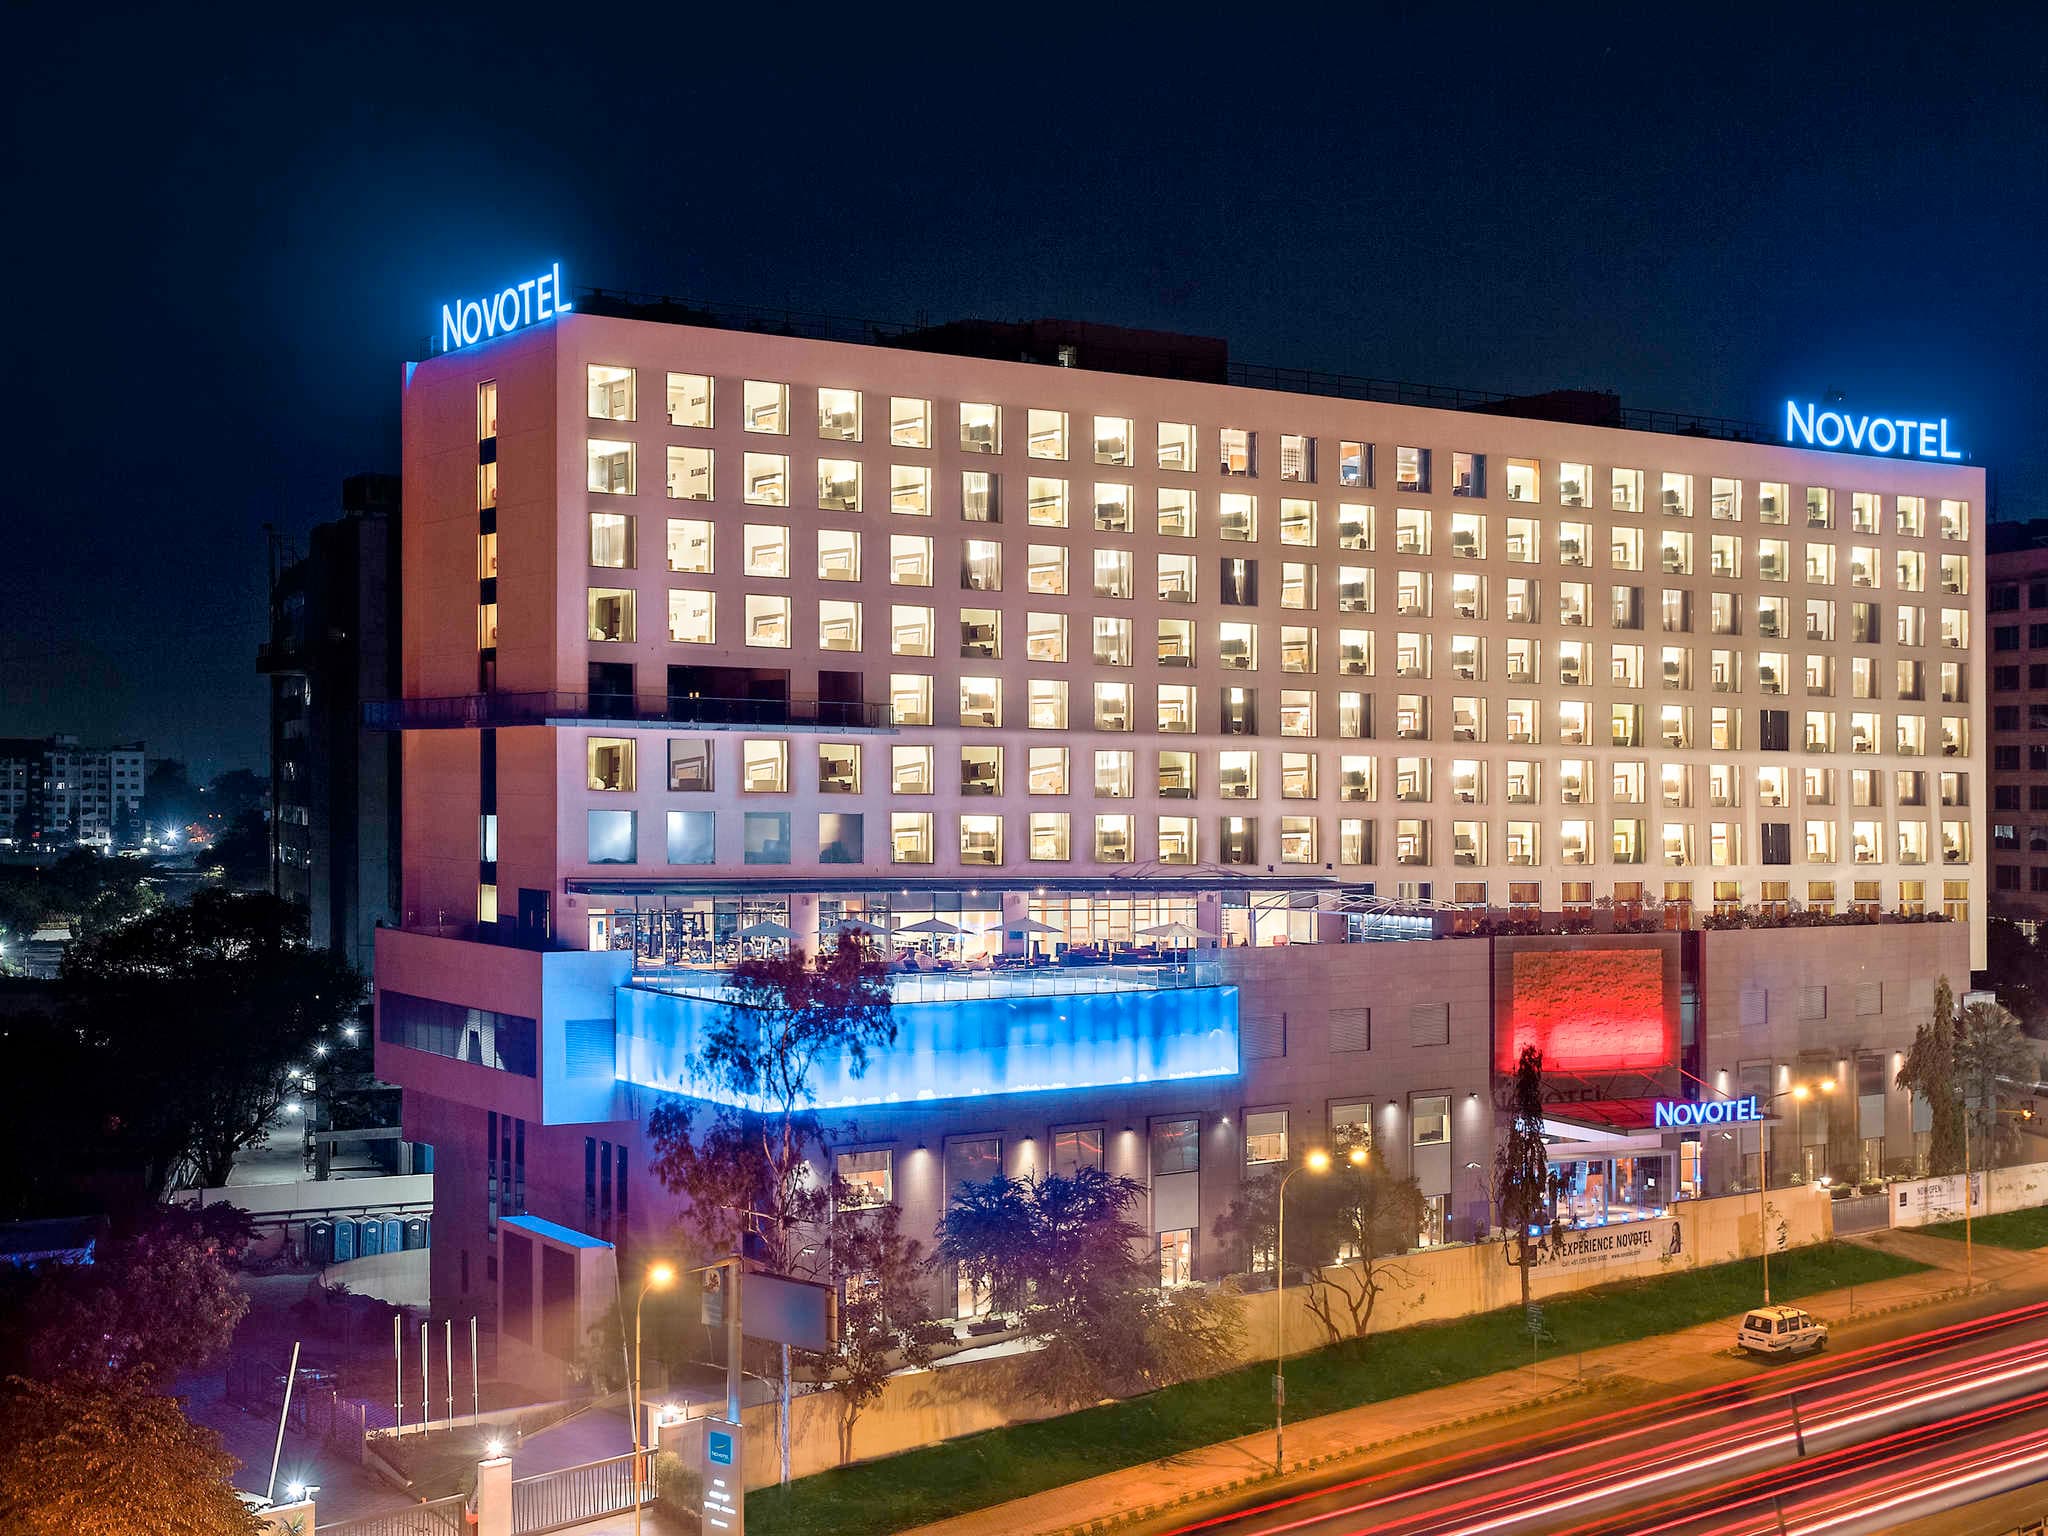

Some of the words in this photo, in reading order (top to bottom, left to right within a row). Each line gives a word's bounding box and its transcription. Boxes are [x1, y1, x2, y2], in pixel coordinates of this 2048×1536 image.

[442, 262, 572, 352] NOVOTEL
[1786, 399, 1961, 459] NOVOTEL
[1654, 1095, 1764, 1128] NOVOTEL
[1562, 1236, 1613, 1257] EXPERIENCE
[1616, 1230, 1652, 1248] NOVOTEL
